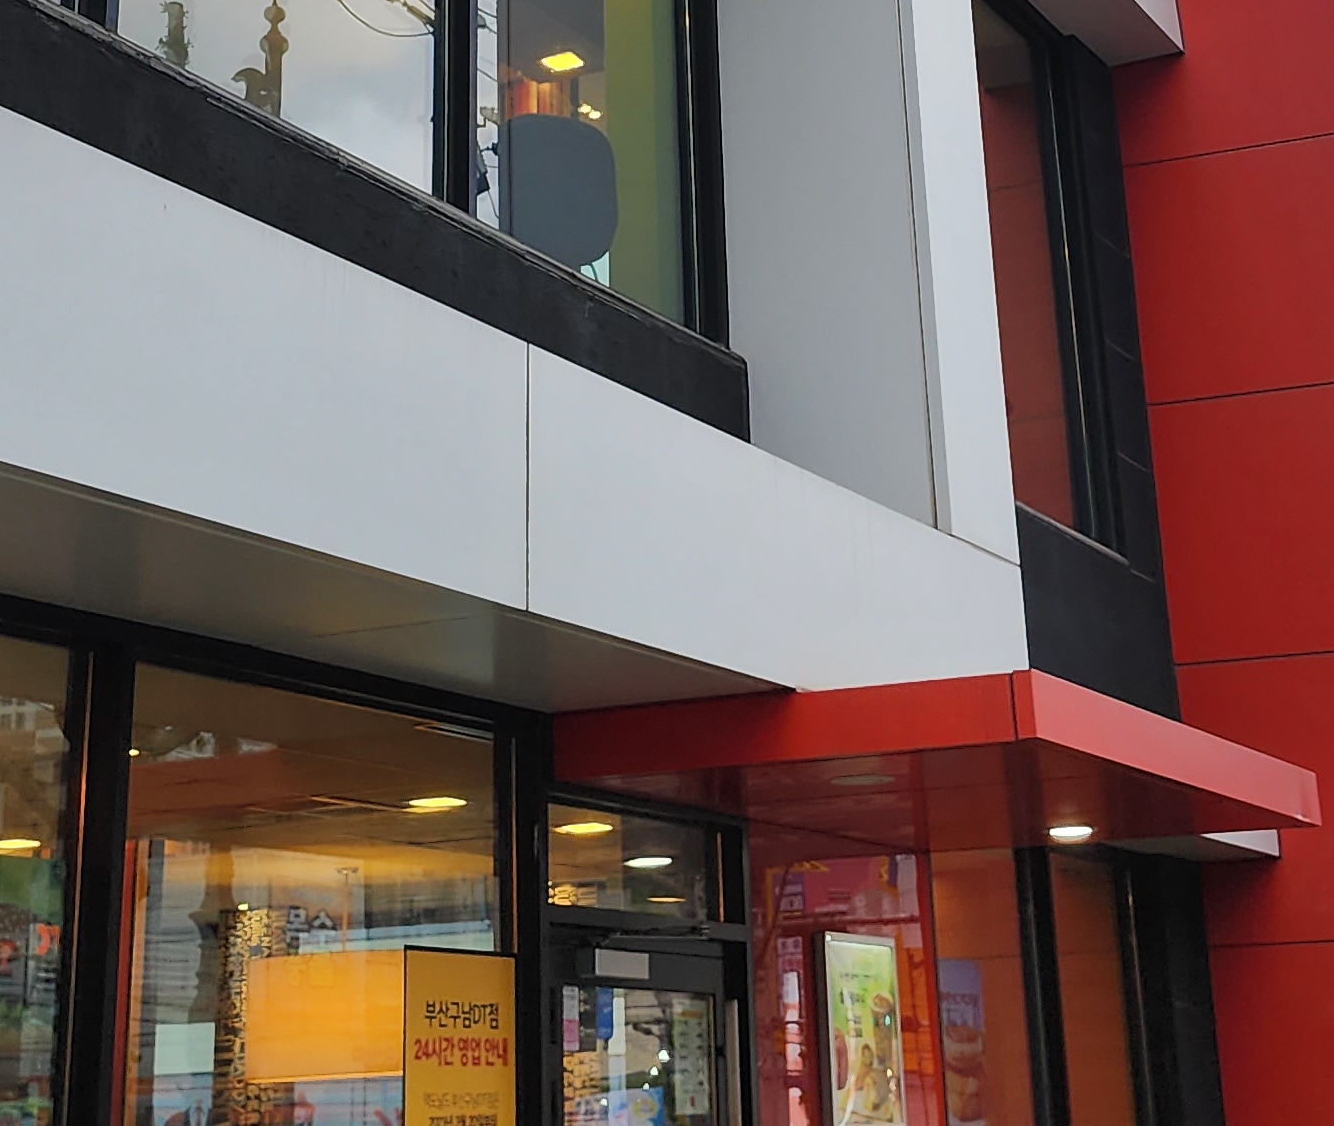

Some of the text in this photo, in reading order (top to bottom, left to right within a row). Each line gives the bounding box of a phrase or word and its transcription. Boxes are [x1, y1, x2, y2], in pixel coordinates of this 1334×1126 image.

[424, 1000, 500, 1030] 부산구남DT점
[414, 1035, 509, 1067] 24시간 영업 안내
